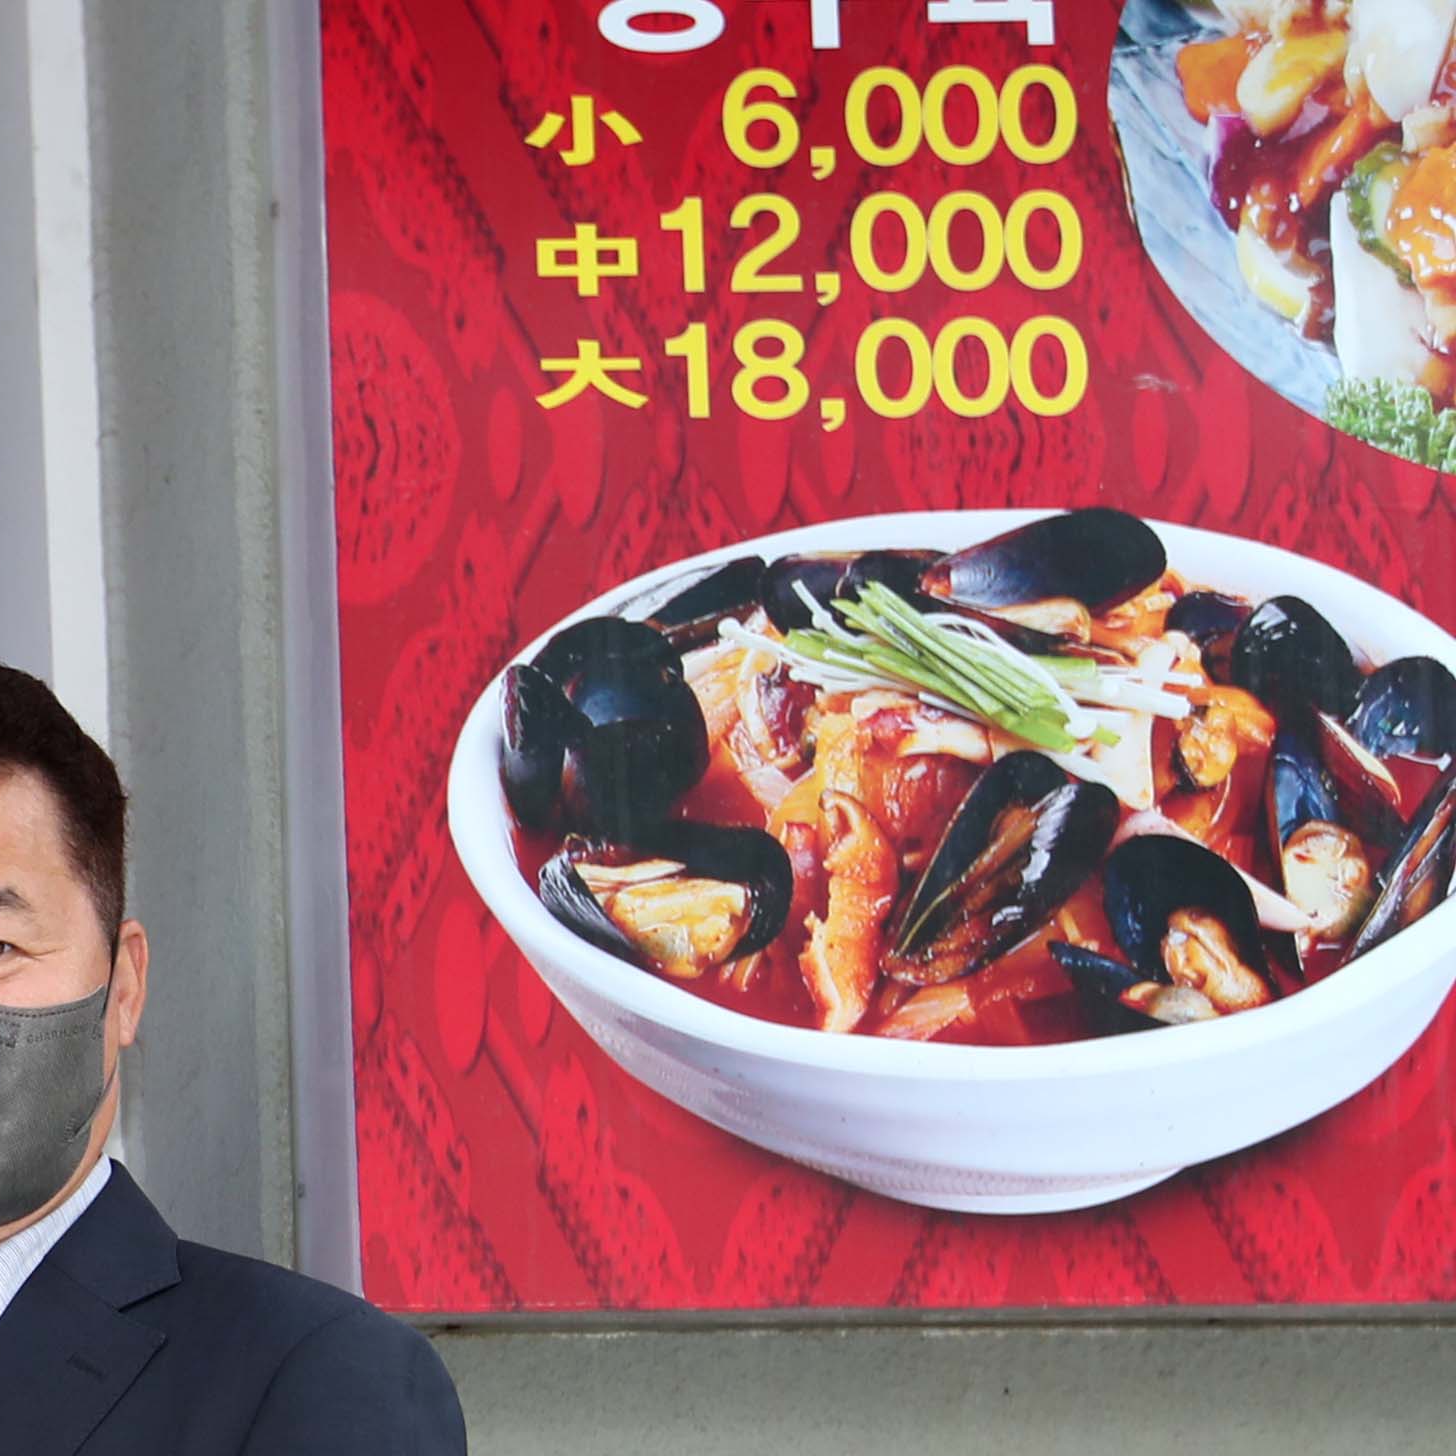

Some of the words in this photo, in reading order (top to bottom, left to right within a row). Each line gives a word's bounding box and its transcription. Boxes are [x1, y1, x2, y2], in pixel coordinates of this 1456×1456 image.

[523, 96, 642, 166] 小
[721, 64, 1078, 179] 6,000
[536, 224, 639, 298] 中
[660, 190, 1084, 306] 12,000
[534, 339, 649, 409] 大
[664, 315, 1089, 431] 18,000
